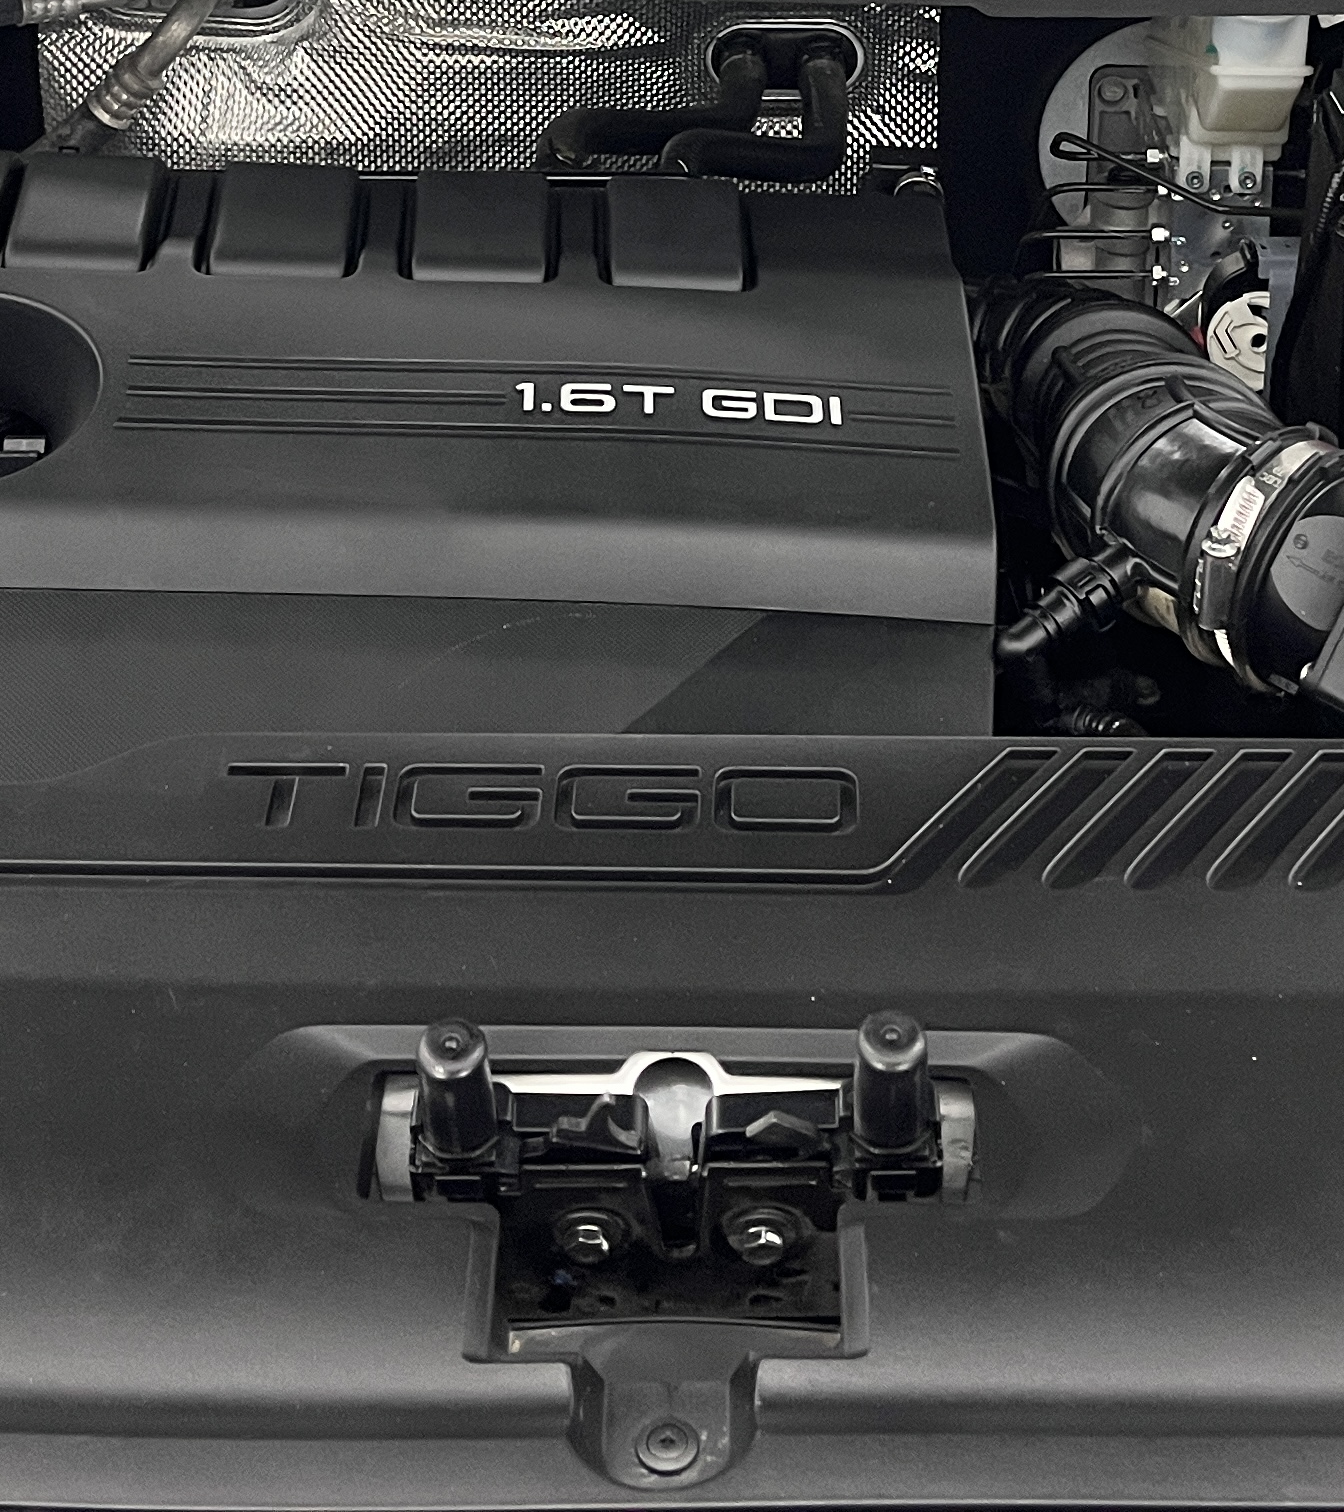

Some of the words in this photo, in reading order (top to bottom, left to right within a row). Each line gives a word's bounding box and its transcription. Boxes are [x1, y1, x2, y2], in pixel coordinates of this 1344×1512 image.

[515, 382, 675, 414] 1.6T
[702, 388, 843, 425] GDI
[227, 761, 859, 834] TIGGO
